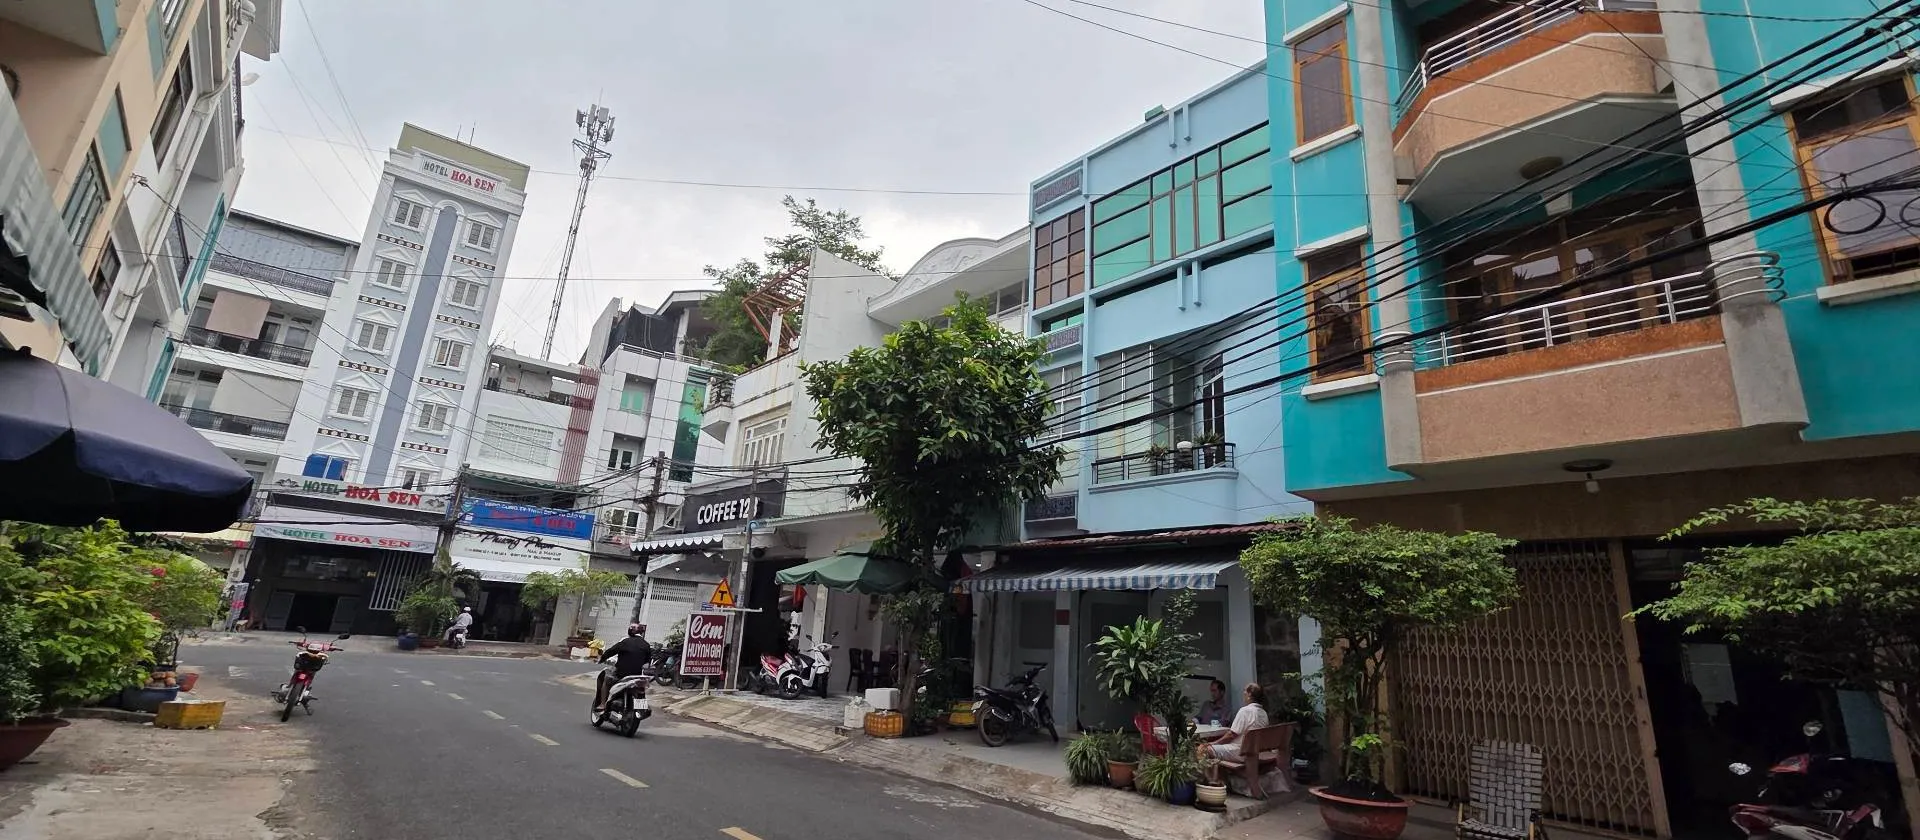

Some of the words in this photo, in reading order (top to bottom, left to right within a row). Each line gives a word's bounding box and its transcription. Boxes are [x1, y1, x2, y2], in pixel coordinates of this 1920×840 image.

[424, 161, 448, 176] HOTEL
[451, 170, 472, 185] HOA
[474, 178, 495, 192] SEN
[303, 480, 339, 495] HOTEL
[344, 485, 380, 501] HOA
[387, 491, 422, 506] SEN
[697, 500, 738, 524] COFFEE
[282, 527, 327, 540] HOTEL
[334, 534, 372, 545] HOA
[377, 538, 411, 548] SEN
[690, 615, 724, 639] Cơm
[687, 641, 710, 658] HUỲNH
[710, 643, 722, 658] GIA
